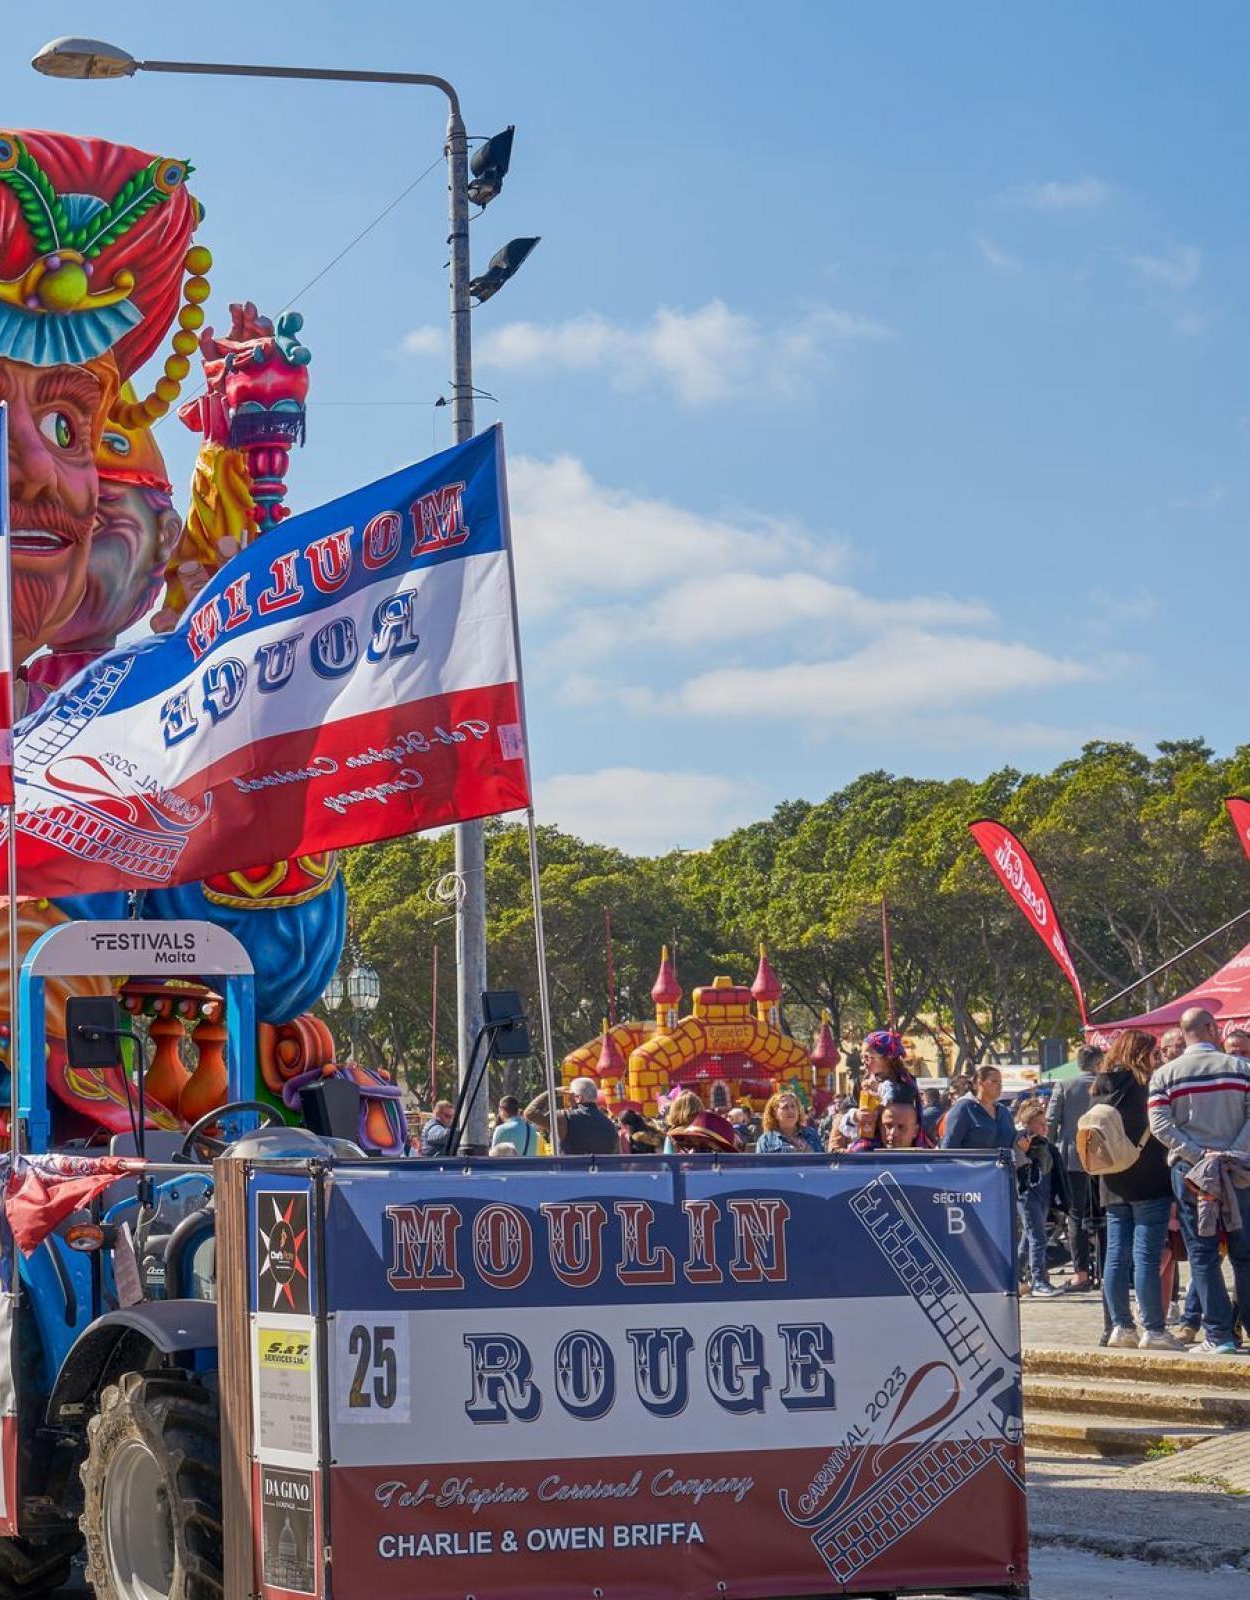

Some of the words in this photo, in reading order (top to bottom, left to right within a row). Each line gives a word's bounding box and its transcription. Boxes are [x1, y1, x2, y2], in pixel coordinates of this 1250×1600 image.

[91, 933, 196, 950] FESTIVALS
[155, 952, 196, 964] Malta
[932, 1192, 981, 1204] SECTION
[947, 1206, 966, 1235] B
[386, 1199, 790, 1291] MOULIN
[348, 1324, 397, 1409] 25
[464, 1322, 835, 1425] ROUGE
[799, 1424, 869, 1514] CARNIVAL
[865, 1365, 908, 1422] 2023
[265, 1478, 280, 1497] DA
[280, 1481, 309, 1501] GINO
[536, 1470, 643, 1502] Carnival
[651, 1468, 754, 1504] Company
[378, 1532, 493, 1558] CHARLIE
[500, 1531, 519, 1552] &
[527, 1526, 604, 1551] OWEN
[613, 1522, 704, 1547] BRIFFA
